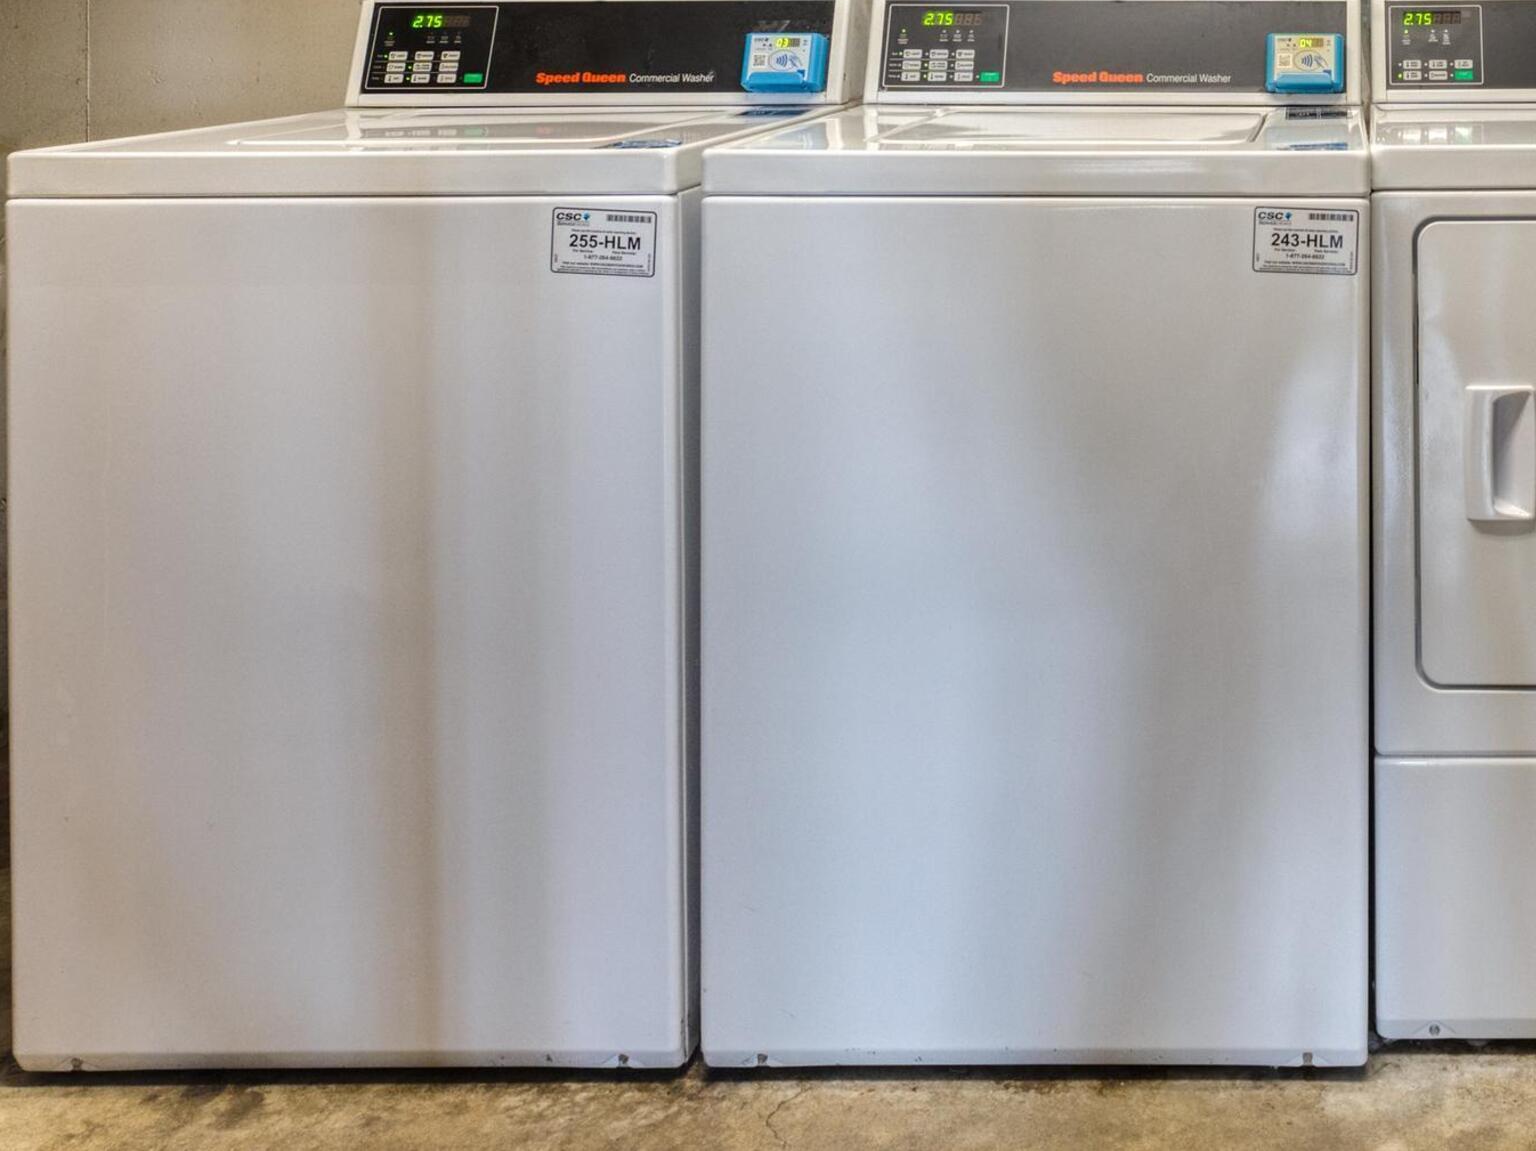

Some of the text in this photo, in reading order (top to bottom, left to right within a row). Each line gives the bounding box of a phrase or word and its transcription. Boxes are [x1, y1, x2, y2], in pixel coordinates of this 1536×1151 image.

[412, 15, 443, 28] 2.75
[923, 12, 954, 26] 2.75
[1403, 13, 1432, 26] 2.75
[1299, 38, 1313, 48] 04
[535, 71, 715, 85] Speed Queen Commercial Washer
[1053, 71, 1232, 85] Speed Queen Commercial Washer
[556, 212, 582, 221] CSC
[1258, 211, 1284, 220] CSC
[569, 233, 641, 250] 255-HLM
[1271, 232, 1343, 249] 243-HLM
